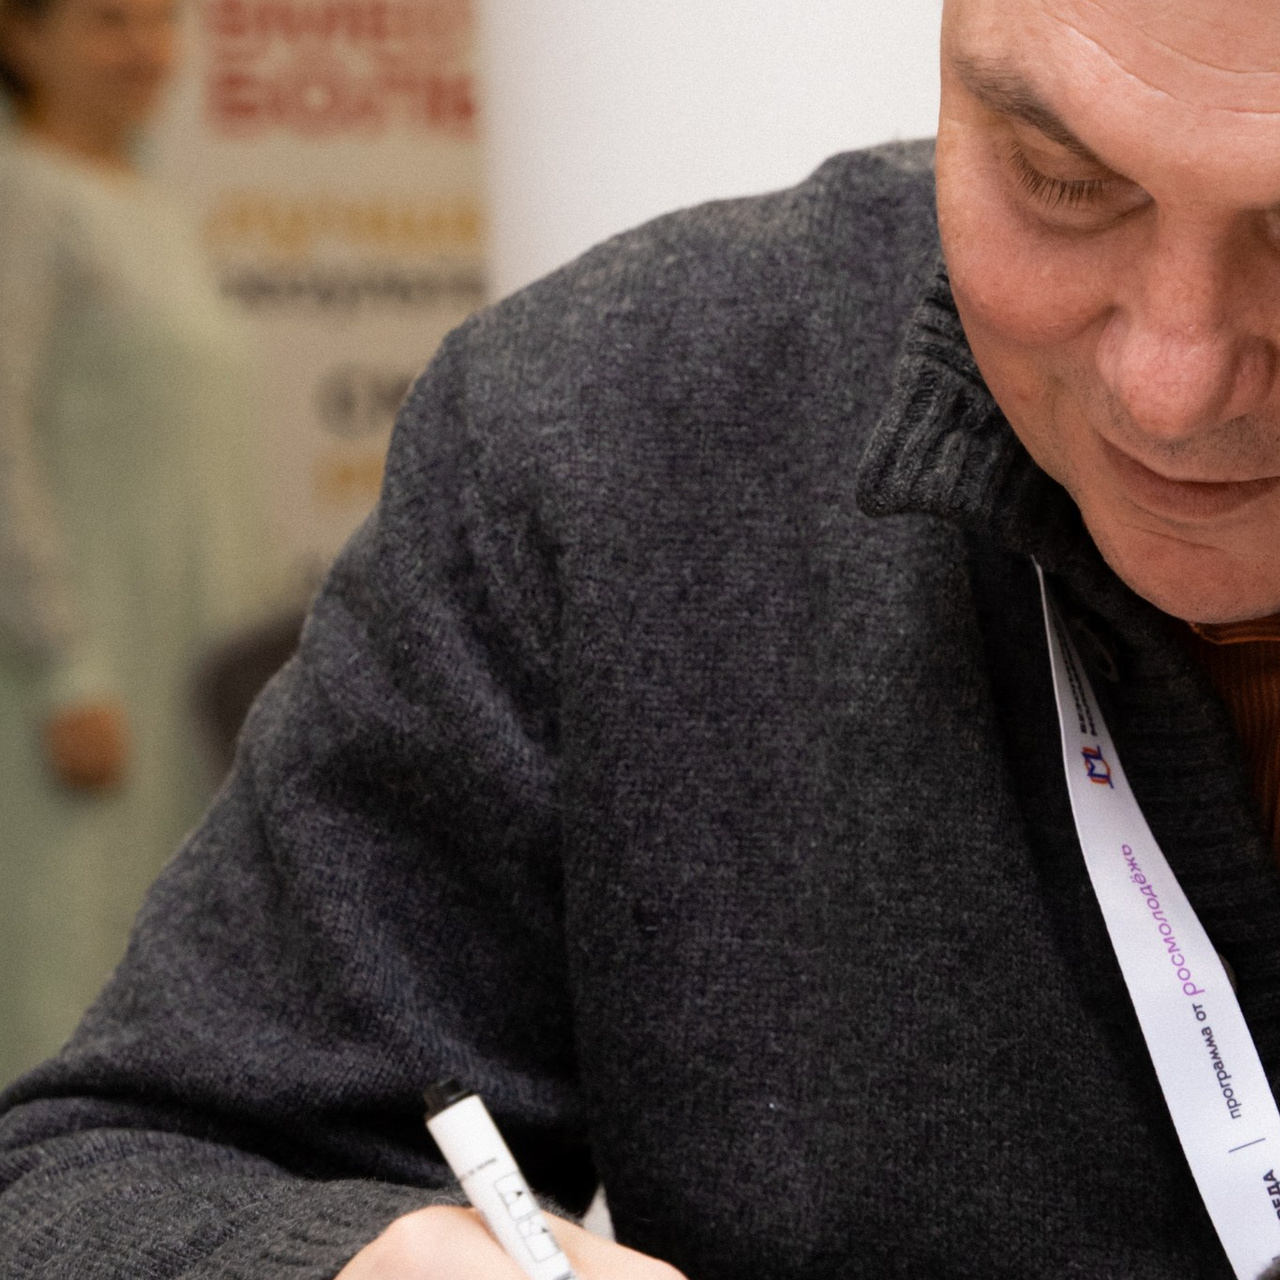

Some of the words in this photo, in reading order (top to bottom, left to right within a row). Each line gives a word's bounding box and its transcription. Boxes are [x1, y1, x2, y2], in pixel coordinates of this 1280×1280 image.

[1121, 843, 1206, 997] росмолодёжь
[1192, 1002, 1207, 1022] от
[1201, 1026, 1242, 1120] программа
